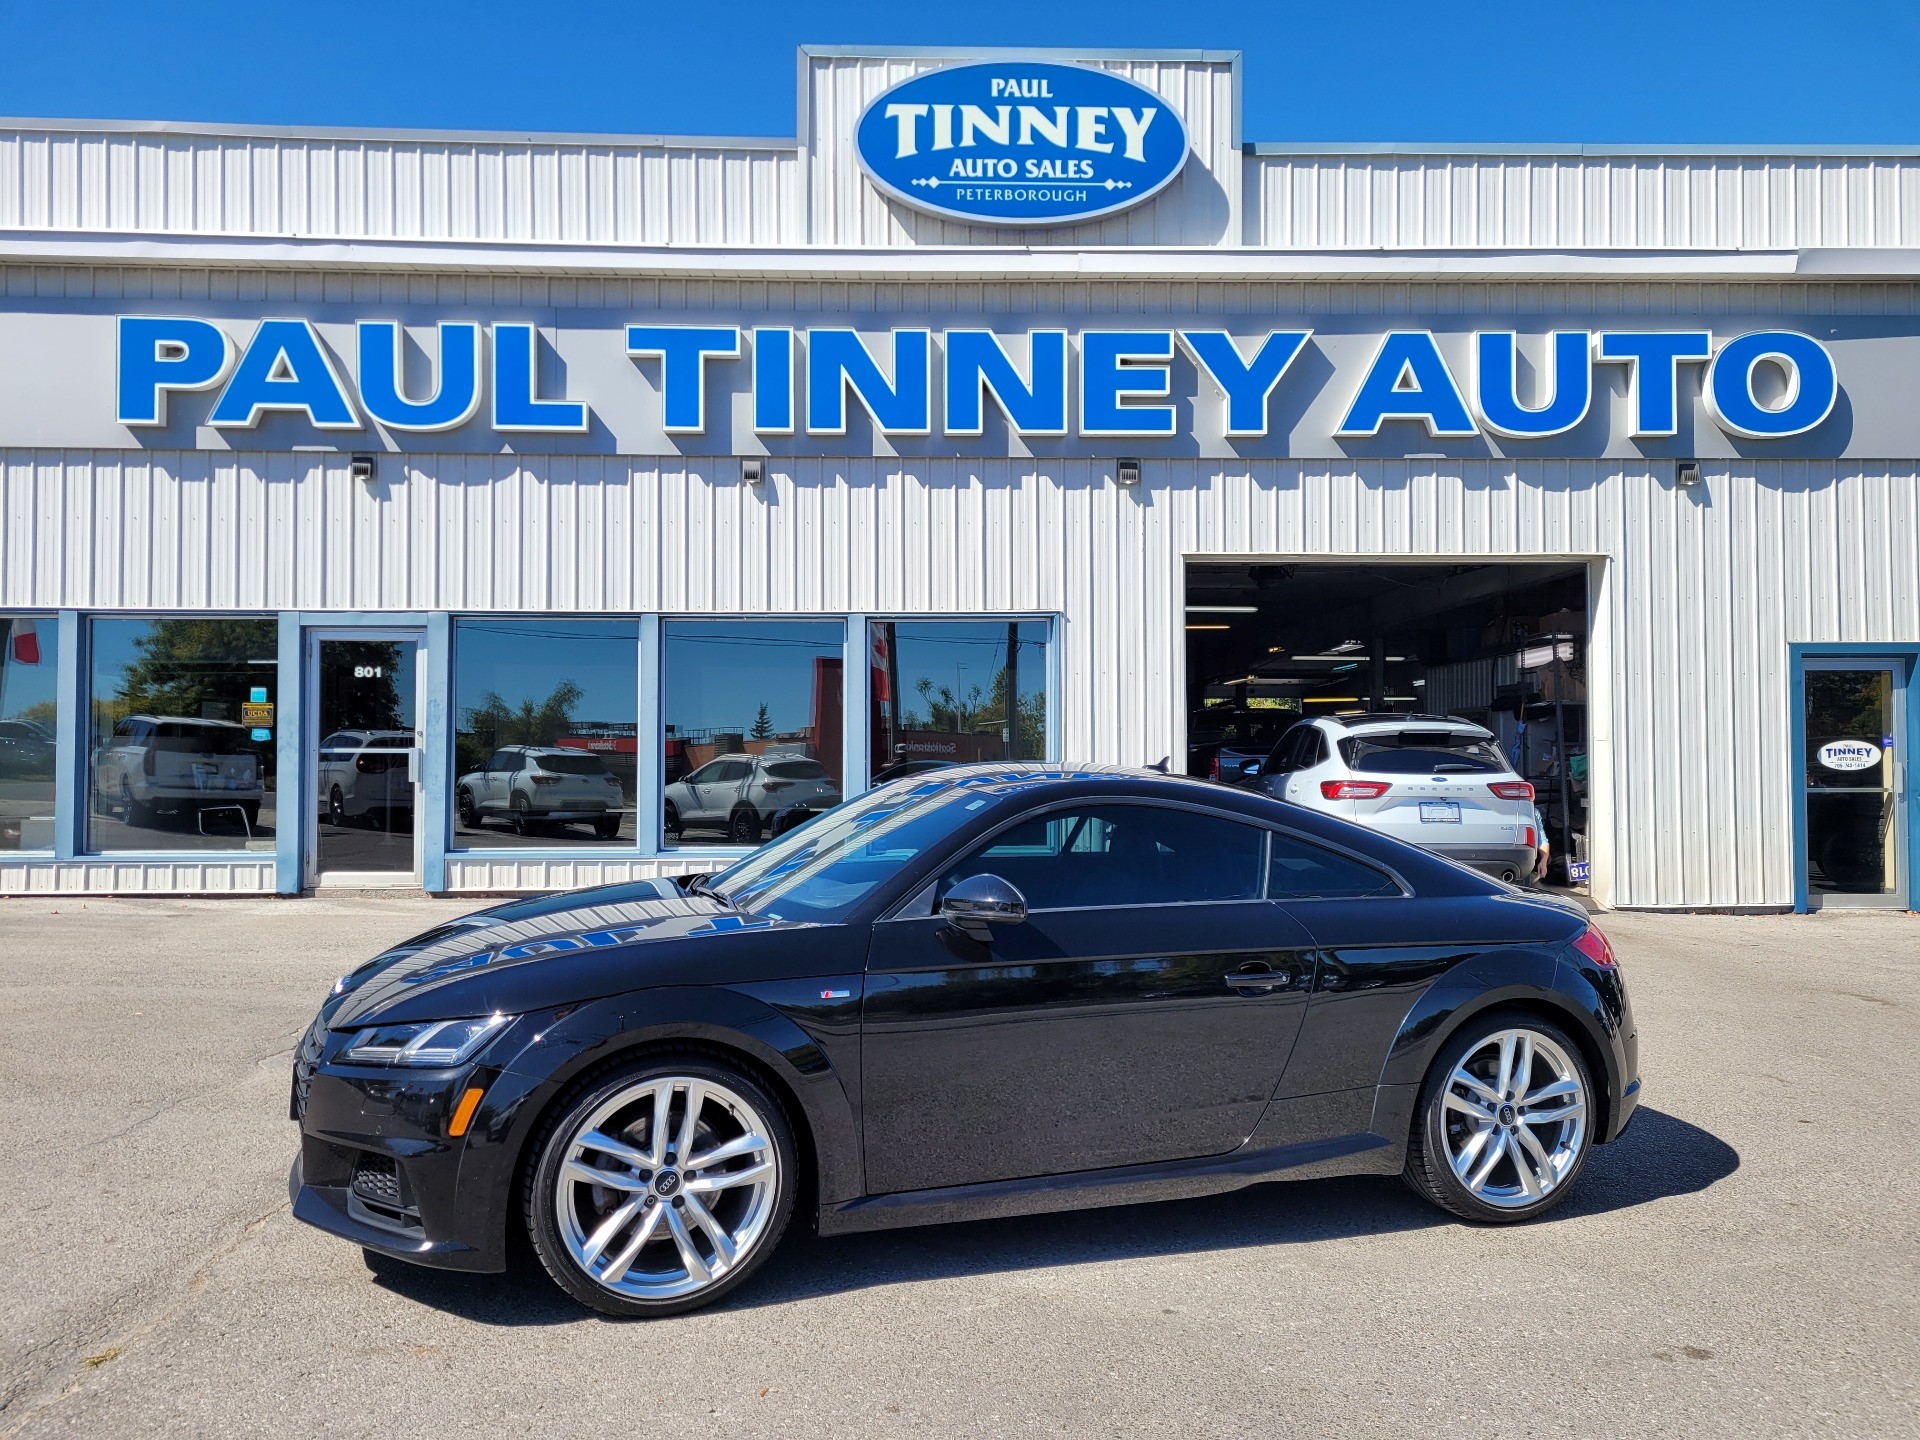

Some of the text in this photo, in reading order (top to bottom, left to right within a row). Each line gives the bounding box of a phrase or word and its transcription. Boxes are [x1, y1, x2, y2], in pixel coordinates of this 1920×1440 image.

[991, 78, 1054, 98] PAUL
[884, 103, 1158, 163] TINNEY
[949, 158, 1095, 179] AUTO SALES
[956, 188, 1087, 203] PETERBOROUGH
[115, 314, 1839, 438] PAUL TINNEY AUTO
[354, 666, 381, 677] 801
[1826, 748, 1872, 758] TINNEY
